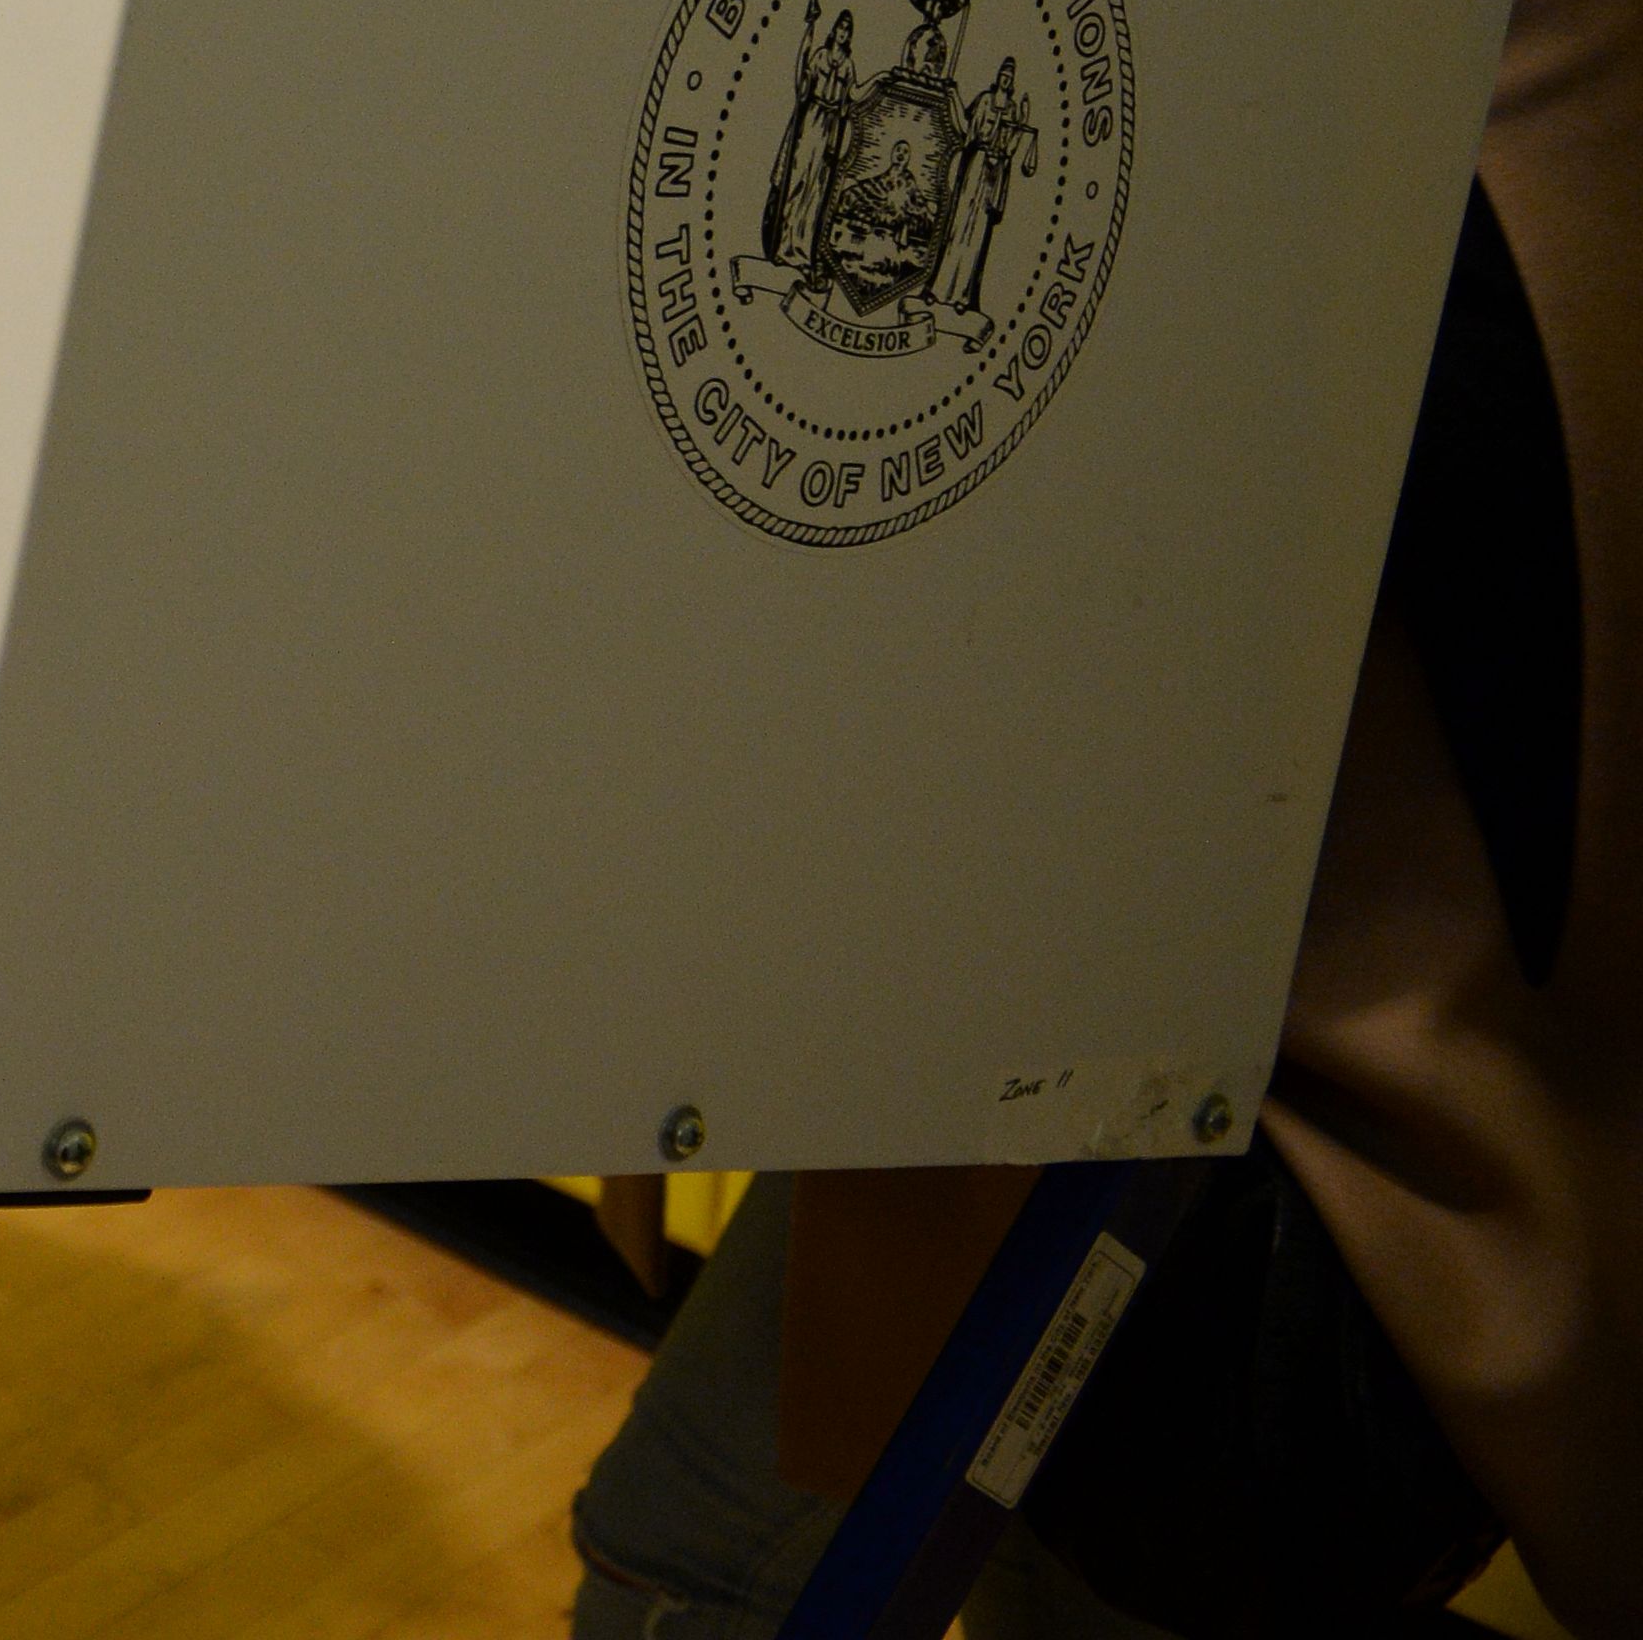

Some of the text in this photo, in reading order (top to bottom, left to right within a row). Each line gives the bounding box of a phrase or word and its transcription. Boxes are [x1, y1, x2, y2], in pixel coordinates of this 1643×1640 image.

[656, 125, 1095, 509] IN THE CITY OF NEW YORK
[804, 309, 911, 352] EXCELSIOR
